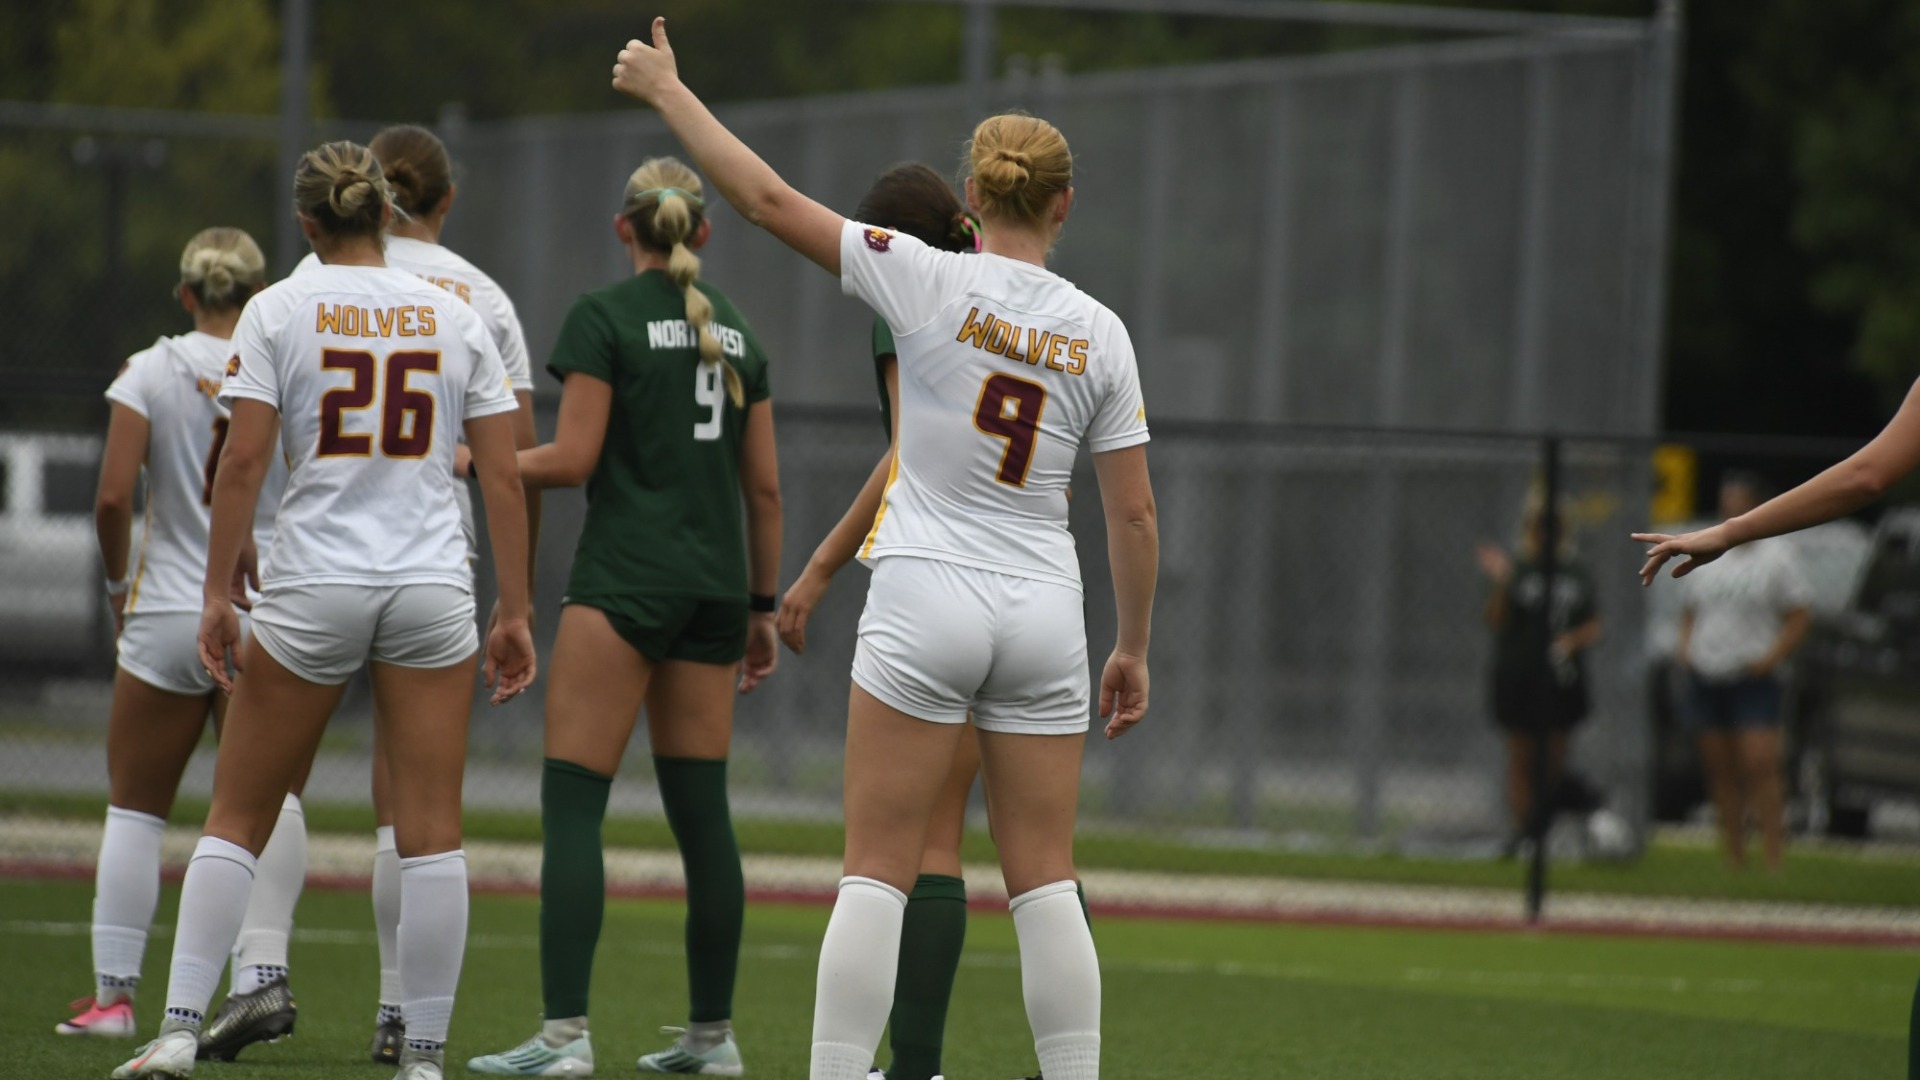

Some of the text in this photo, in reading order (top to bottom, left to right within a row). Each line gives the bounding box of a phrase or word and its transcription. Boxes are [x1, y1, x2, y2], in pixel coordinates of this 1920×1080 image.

[316, 302, 436, 337] WOLVES
[647, 319, 745, 358] NORTWEST
[956, 306, 1089, 375] WOLVES
[318, 347, 441, 459] 26
[694, 359, 724, 441] 9
[972, 371, 1048, 488] 9
